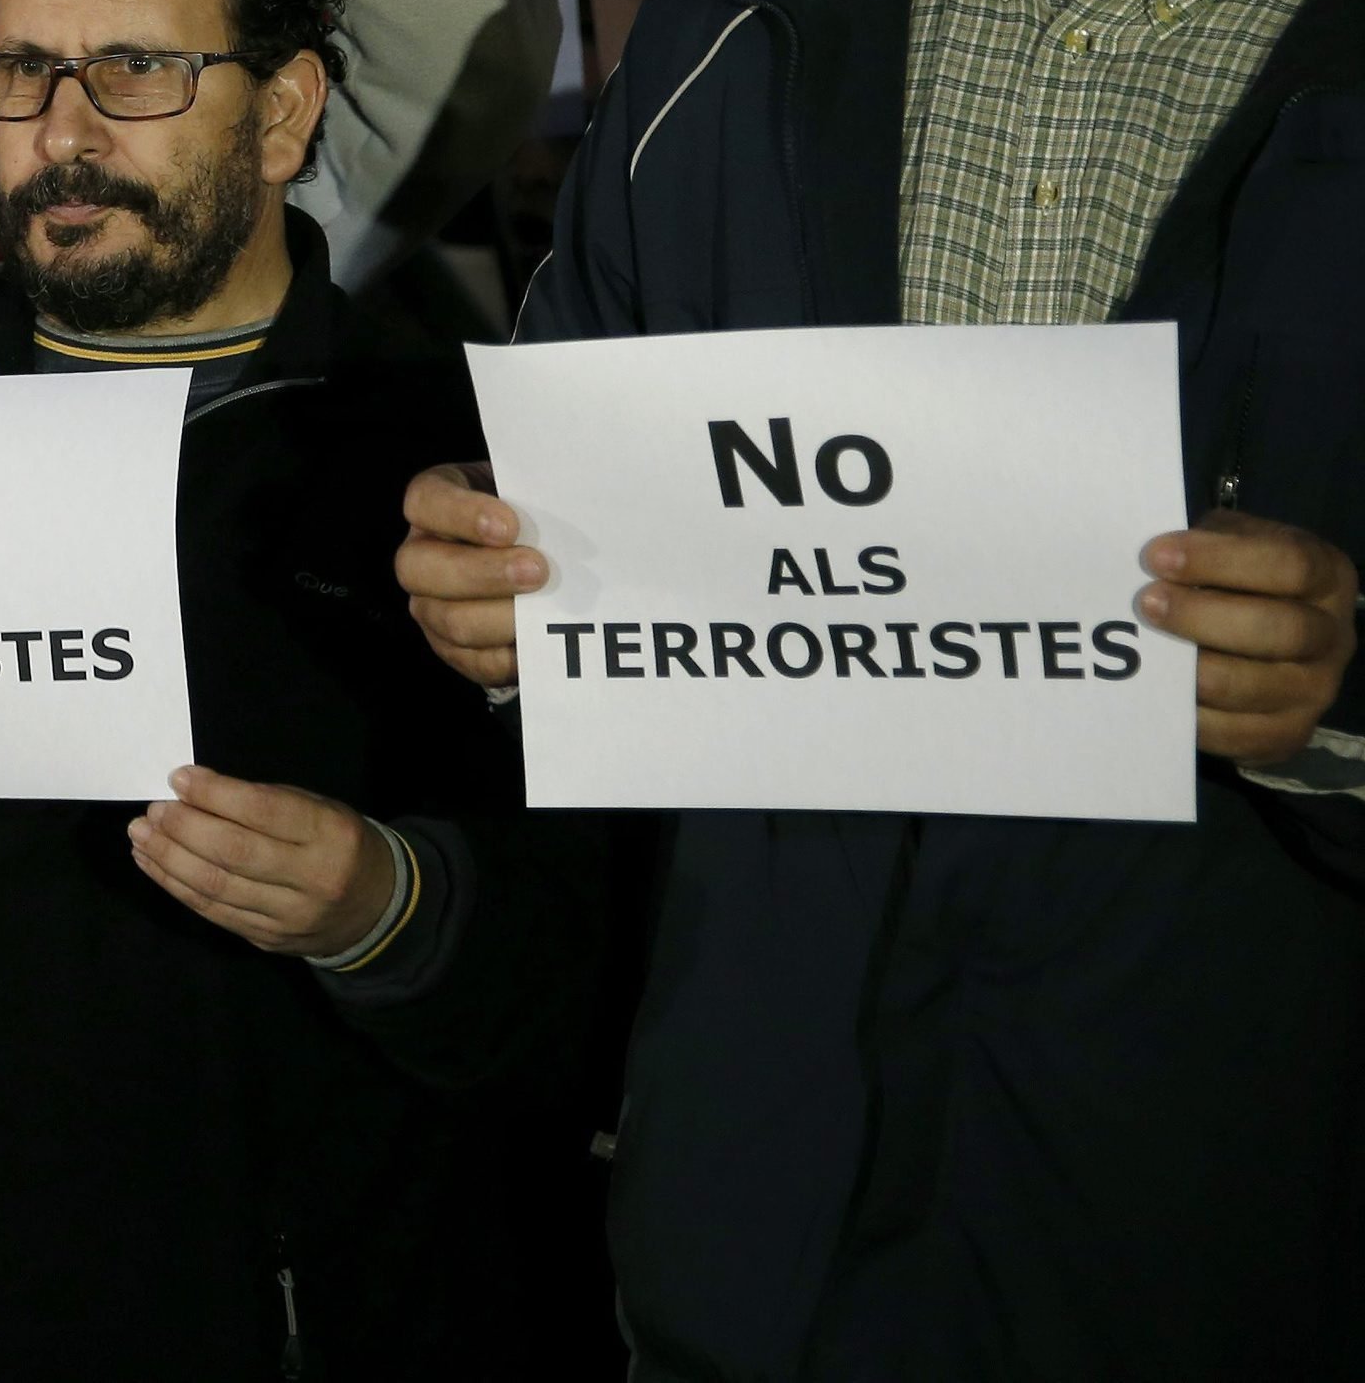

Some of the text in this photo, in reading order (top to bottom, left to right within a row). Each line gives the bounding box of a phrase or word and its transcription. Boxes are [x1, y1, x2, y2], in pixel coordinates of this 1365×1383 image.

[707, 417, 894, 508] No
[767, 545, 907, 596] ALS
[546, 618, 1144, 681] TERRORISTES
